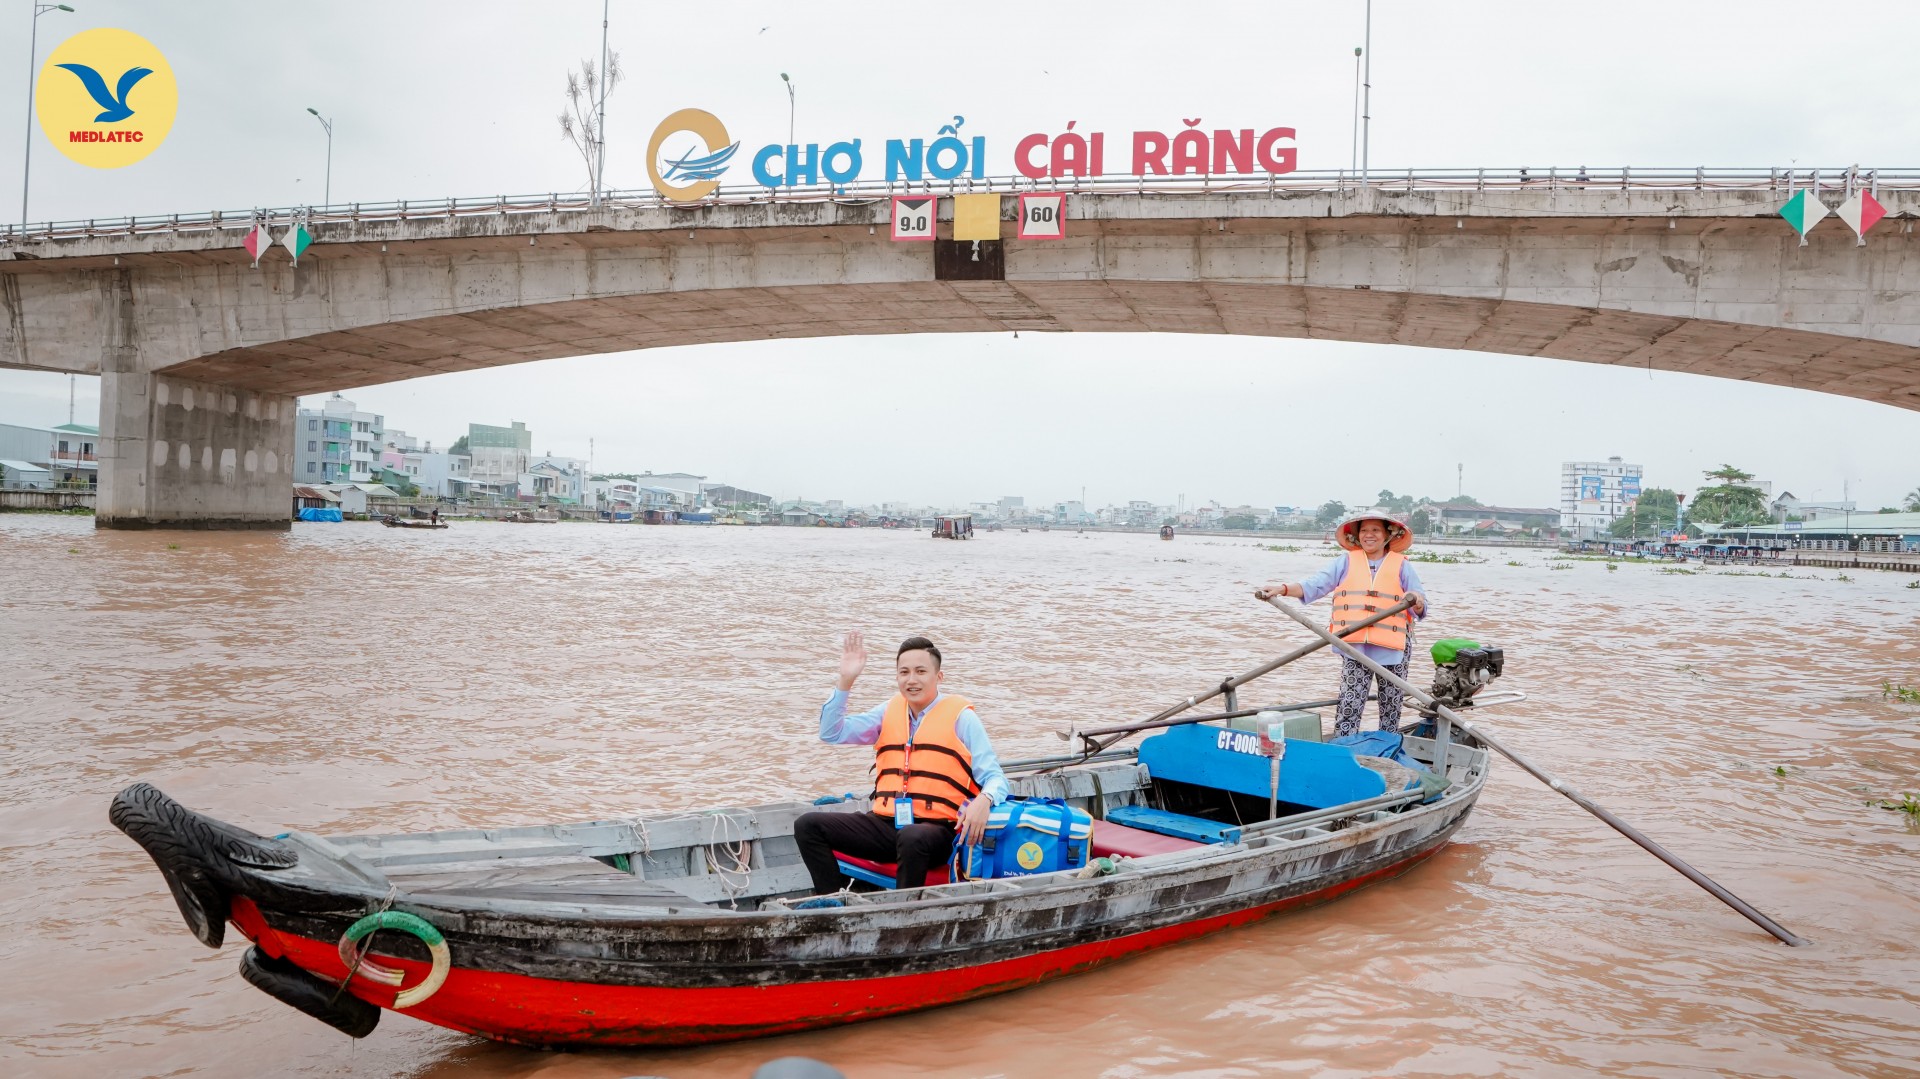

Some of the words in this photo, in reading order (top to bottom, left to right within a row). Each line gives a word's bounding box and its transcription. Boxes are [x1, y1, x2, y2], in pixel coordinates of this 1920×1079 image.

[752, 138, 863, 196] CHỢ
[885, 115, 986, 182] NỔI
[1014, 120, 1104, 179] CÁI
[1132, 118, 1298, 175] RĂNG
[1030, 206, 1053, 223] 60
[900, 215, 927, 232] 9.0
